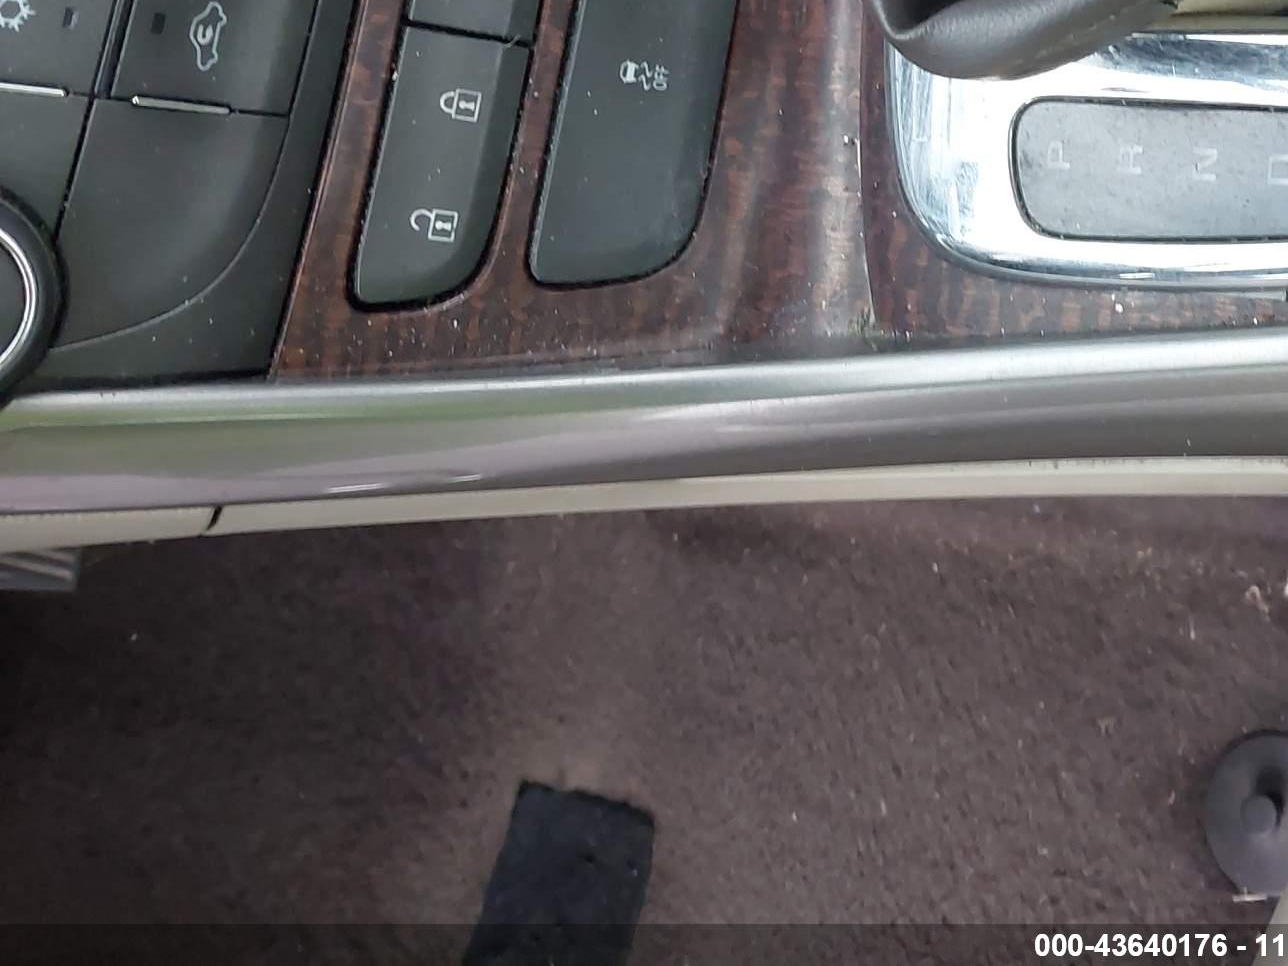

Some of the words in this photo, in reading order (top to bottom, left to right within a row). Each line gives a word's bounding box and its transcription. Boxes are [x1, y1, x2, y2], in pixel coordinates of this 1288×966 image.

[653, 63, 670, 91] OFF
[1047, 140, 1070, 171] P
[1192, 146, 1218, 181] N
